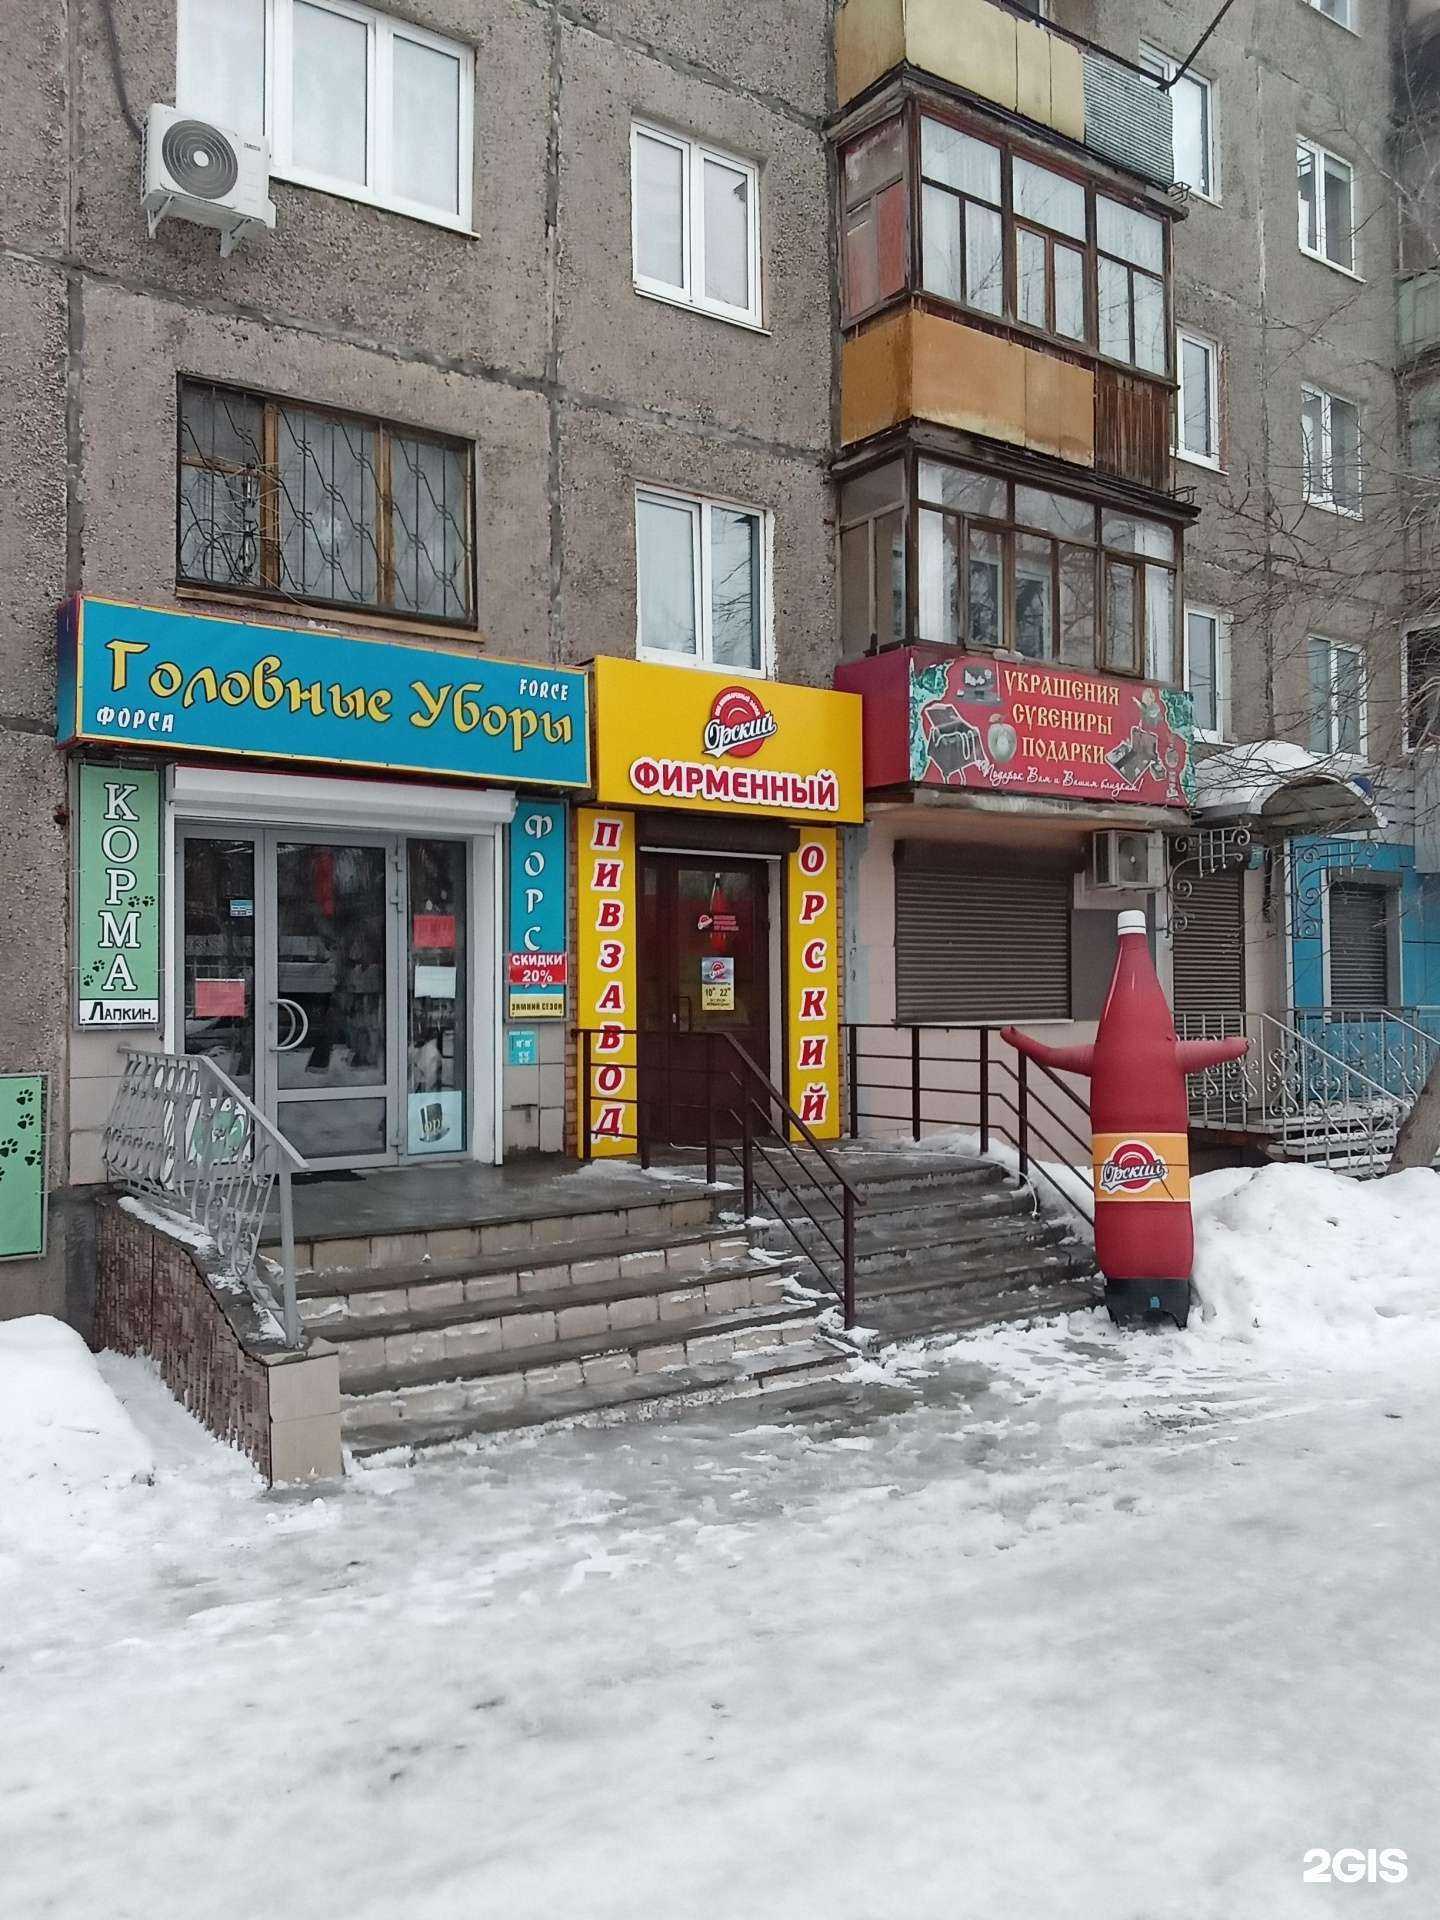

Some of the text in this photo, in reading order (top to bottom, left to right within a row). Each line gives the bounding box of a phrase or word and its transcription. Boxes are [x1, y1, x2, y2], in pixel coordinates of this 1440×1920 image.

[104, 638, 573, 752] Головные Уборы
[519, 677, 569, 702] FORCE
[1003, 669, 1120, 706] УКРАШЕНИЯ
[95, 706, 175, 733] ФОРСА
[1012, 703, 1113, 735] СУВЕНИРЫ
[1021, 737, 1106, 765] ПОДАРКИ
[631, 759, 837, 809] ФИРМЕННЫЙ
[98, 783, 141, 991] КОРМА
[523, 813, 553, 988] ФОРС
[512, 954, 563, 968] СКИДКИ
[522, 969, 553, 984] 20%
[592, 819, 625, 1142] ПИВЗАВОД
[798, 843, 828, 1123] ОРСКИЙ
